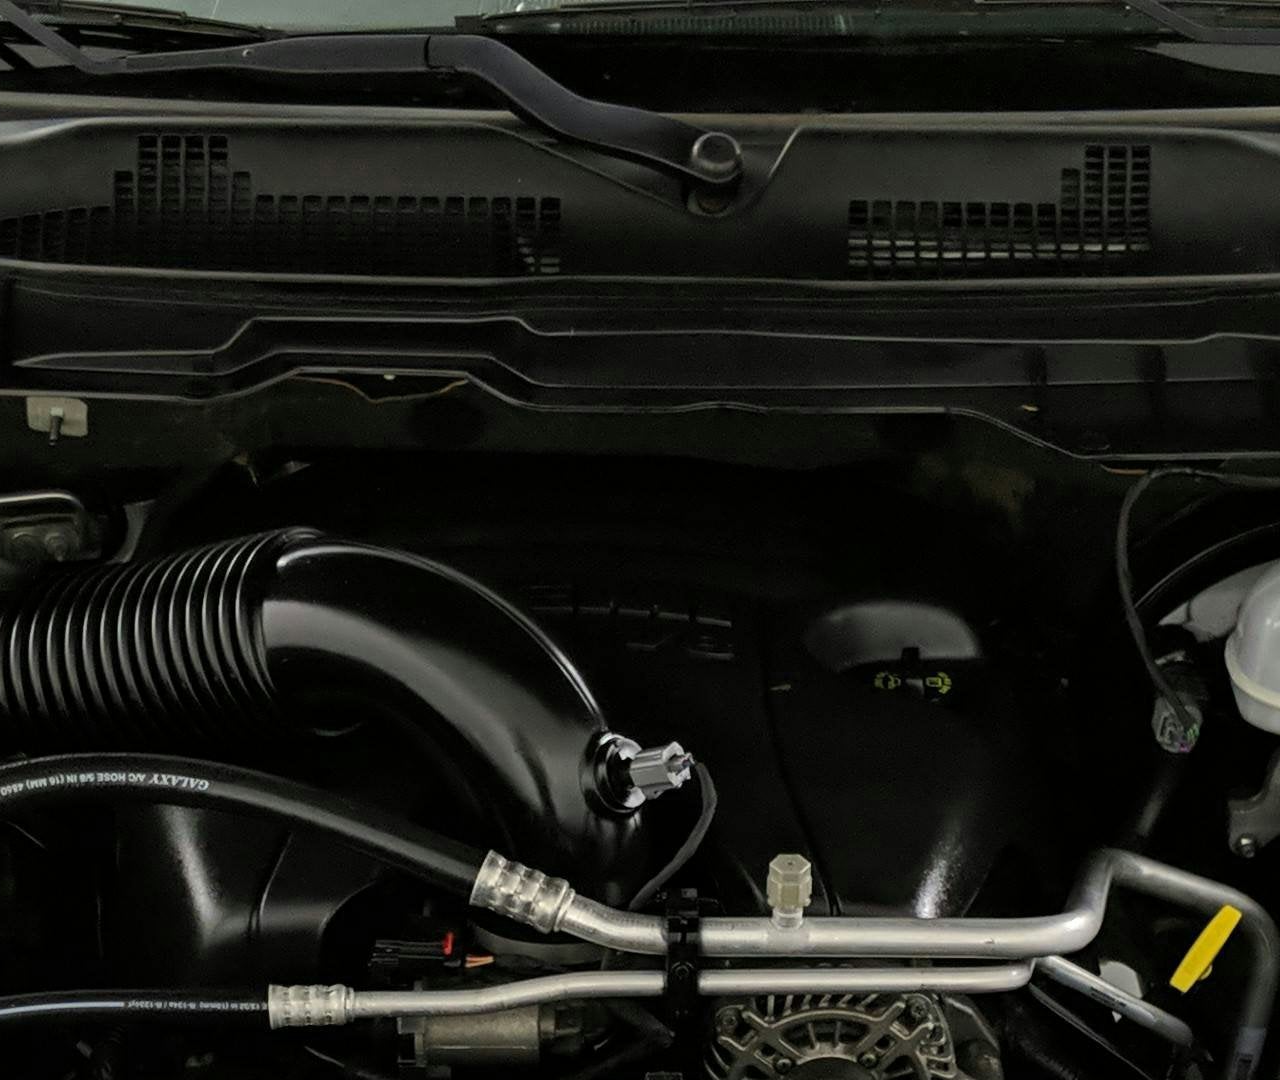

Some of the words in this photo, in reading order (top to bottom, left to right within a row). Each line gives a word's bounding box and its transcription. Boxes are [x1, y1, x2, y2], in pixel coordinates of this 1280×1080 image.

[96, 771, 125, 783] HOSE
[127, 772, 145, 782] A/C
[148, 773, 208, 790] GALAXY
